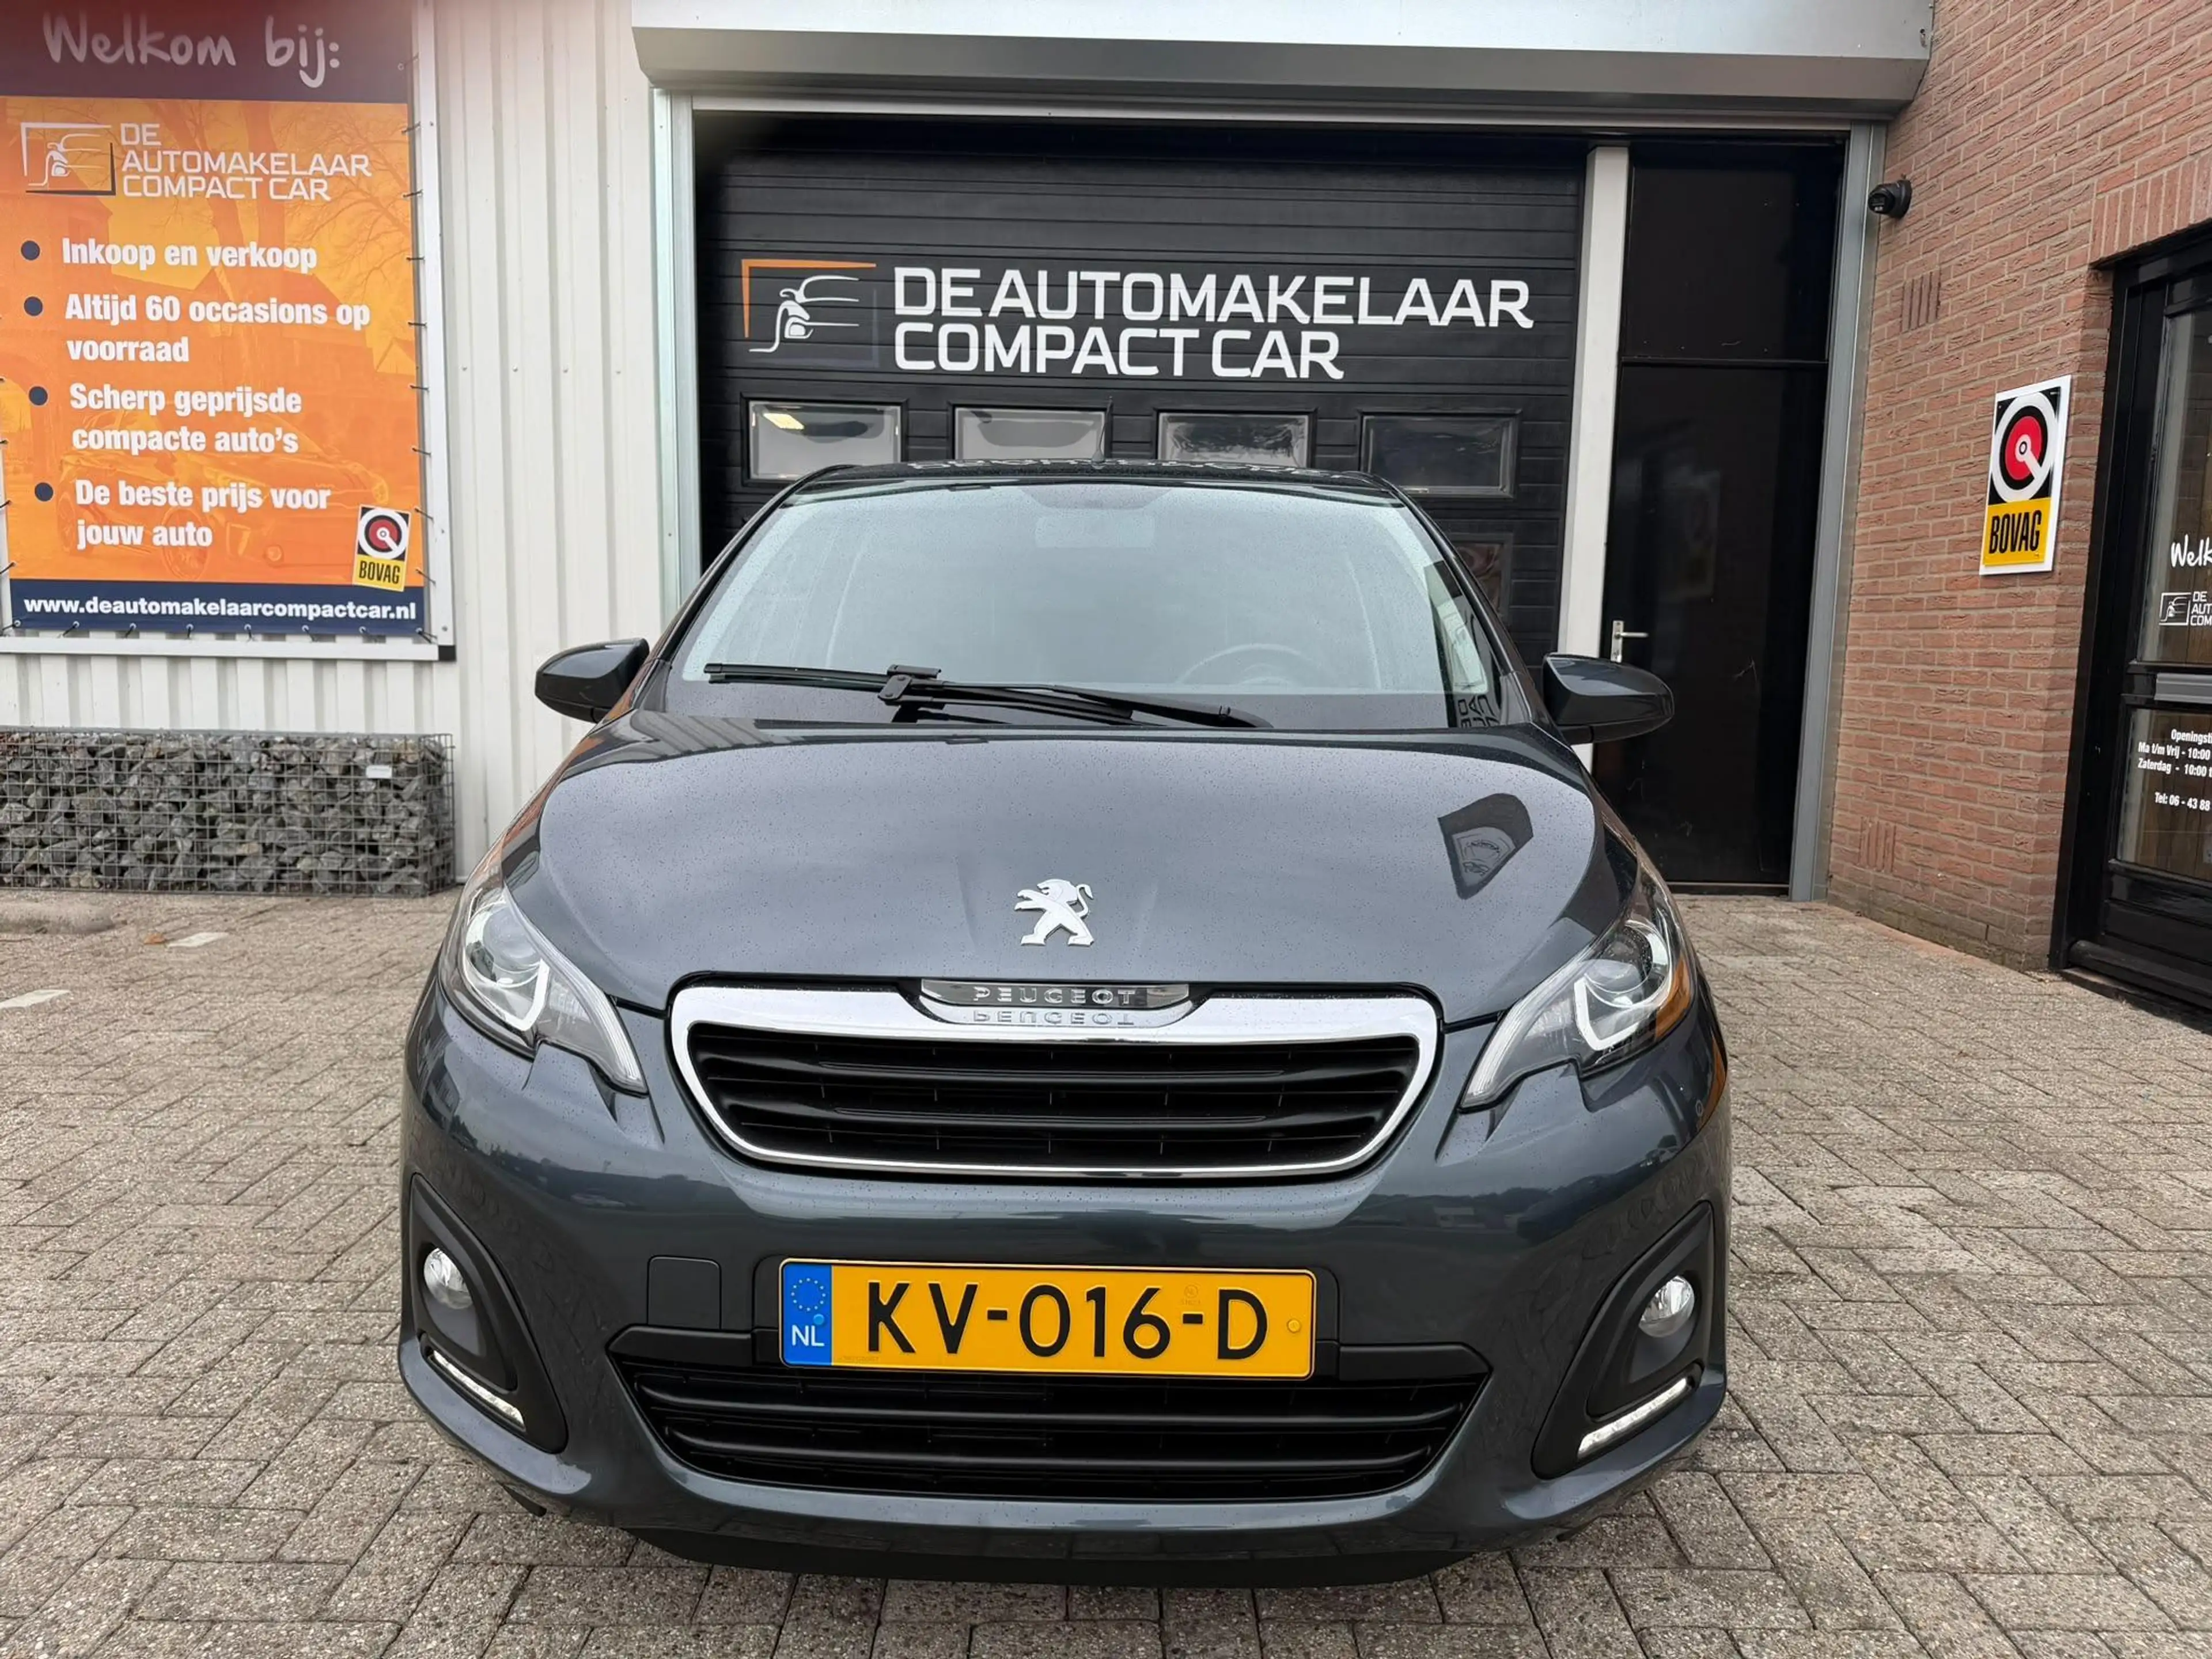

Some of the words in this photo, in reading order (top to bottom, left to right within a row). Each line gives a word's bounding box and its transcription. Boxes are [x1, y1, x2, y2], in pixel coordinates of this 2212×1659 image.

[43, 10, 236, 66] Welkom
[265, 15, 340, 88] bij:
[120, 123, 162, 146] DE
[122, 150, 372, 177] AUTOMAKELAAR
[123, 175, 263, 199] COMPACT
[269, 177, 332, 201] CAR
[62, 237, 156, 270] Inkoop
[164, 246, 197, 266] en
[207, 241, 317, 274] verkoop
[65, 293, 136, 326] Altijd
[146, 296, 180, 321] 60
[189, 297, 327, 325] occasions
[336, 305, 370, 328] op
[895, 266, 982, 317] DE
[989, 268, 1535, 329] AUTOMAKELAAR
[67, 337, 189, 362] voorraad
[895, 321, 1201, 376] COMPACT
[1211, 329, 1344, 380] CAR
[70, 383, 165, 415] Scherp
[175, 387, 301, 417] geprijsde
[73, 427, 206, 455] compacte
[75, 479, 109, 505] De
[119, 481, 193, 507] beste
[202, 483, 263, 513] prijs
[271, 486, 331, 509] voor
[77, 520, 143, 550] jouw
[153, 524, 213, 547] auto
[1988, 510, 2042, 554] BOVAG
[2171, 533, 2212, 568] Welk
[359, 560, 400, 584] BOVAG
[24, 596, 416, 620] www.deautomakelaarcompactcar.nl
[2192, 590, 2207, 602] DE
[2190, 615, 2212, 626] COM
[2138, 741, 2150, 753] Ma
[2152, 743, 2165, 755] t/m
[2188, 747, 2211, 760] 10:00
[2138, 757, 2172, 775] Zaterdag
[2184, 763, 2207, 777] 10:00
[2169, 794, 2180, 806] 06
[2187, 797, 2198, 809] 43
[972, 986, 1137, 1005] PEUGEOT
[868, 1280, 1268, 1360] KV-016-D
[791, 1324, 825, 1347] NL
